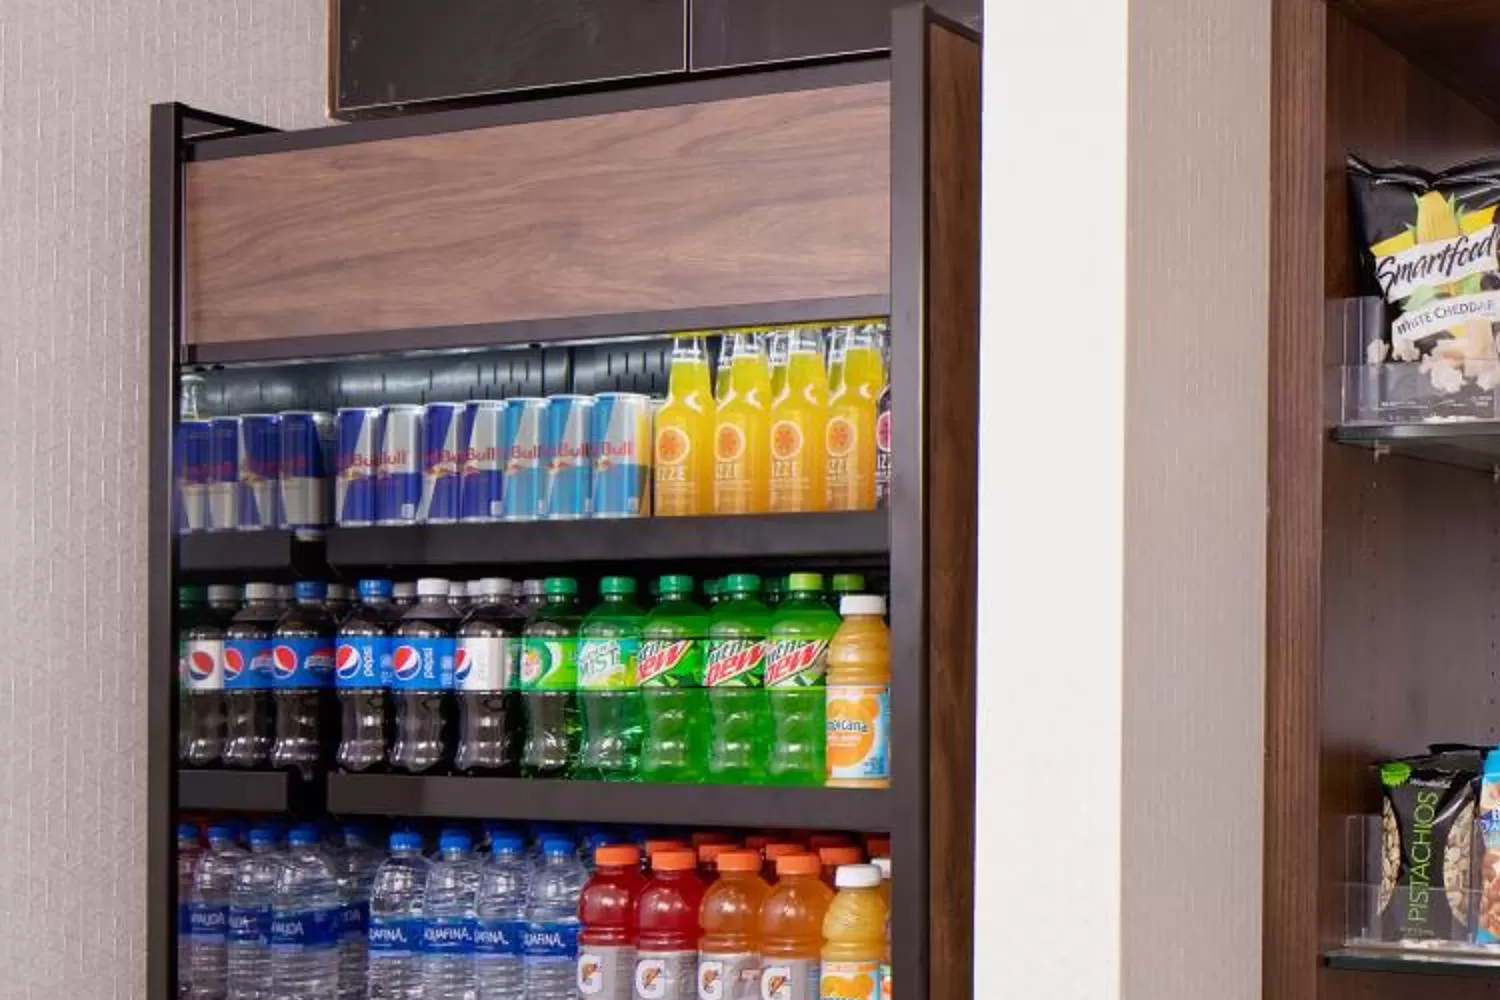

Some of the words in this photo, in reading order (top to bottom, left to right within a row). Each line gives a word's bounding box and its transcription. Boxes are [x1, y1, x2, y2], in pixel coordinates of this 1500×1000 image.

[1376, 224, 1498, 301] Smartfood
[1397, 311, 1433, 335] WHITE
[363, 646, 375, 678] pepsi
[423, 647, 436, 679] pepsi
[1407, 791, 1439, 924] PISTACHIOS
